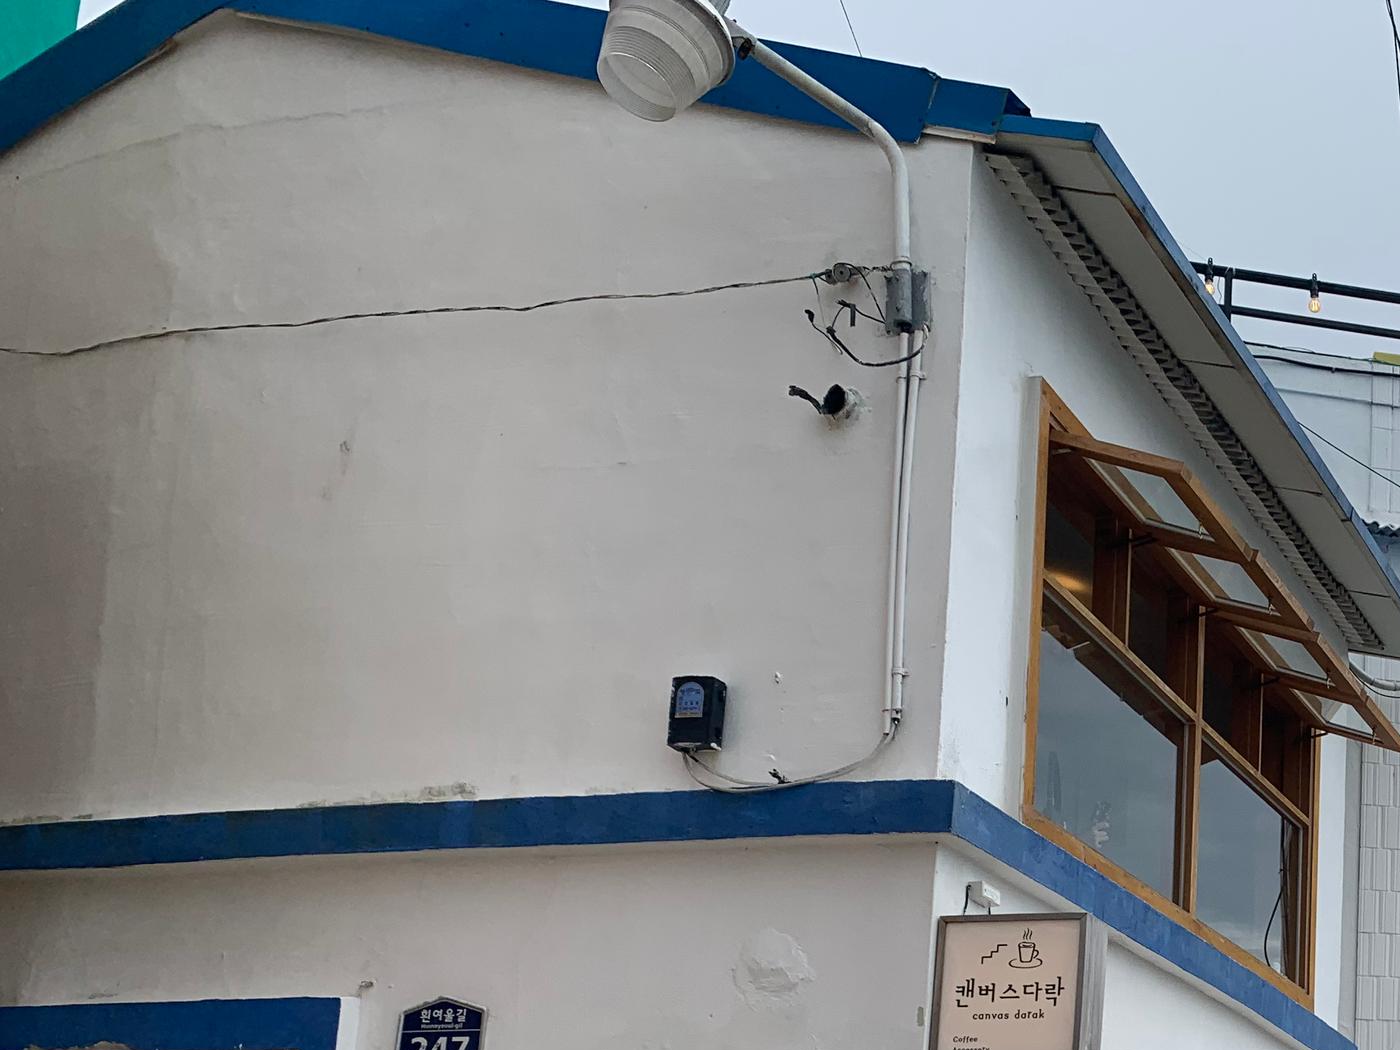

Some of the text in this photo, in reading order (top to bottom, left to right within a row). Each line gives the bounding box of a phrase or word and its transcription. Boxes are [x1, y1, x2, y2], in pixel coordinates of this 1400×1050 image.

[955, 976, 1065, 1008] 캔버스다락
[420, 1008, 467, 1023] 흰여울길
[972, 1009, 1045, 1020] canvas darak
[952, 1035, 978, 1043] Coffee
